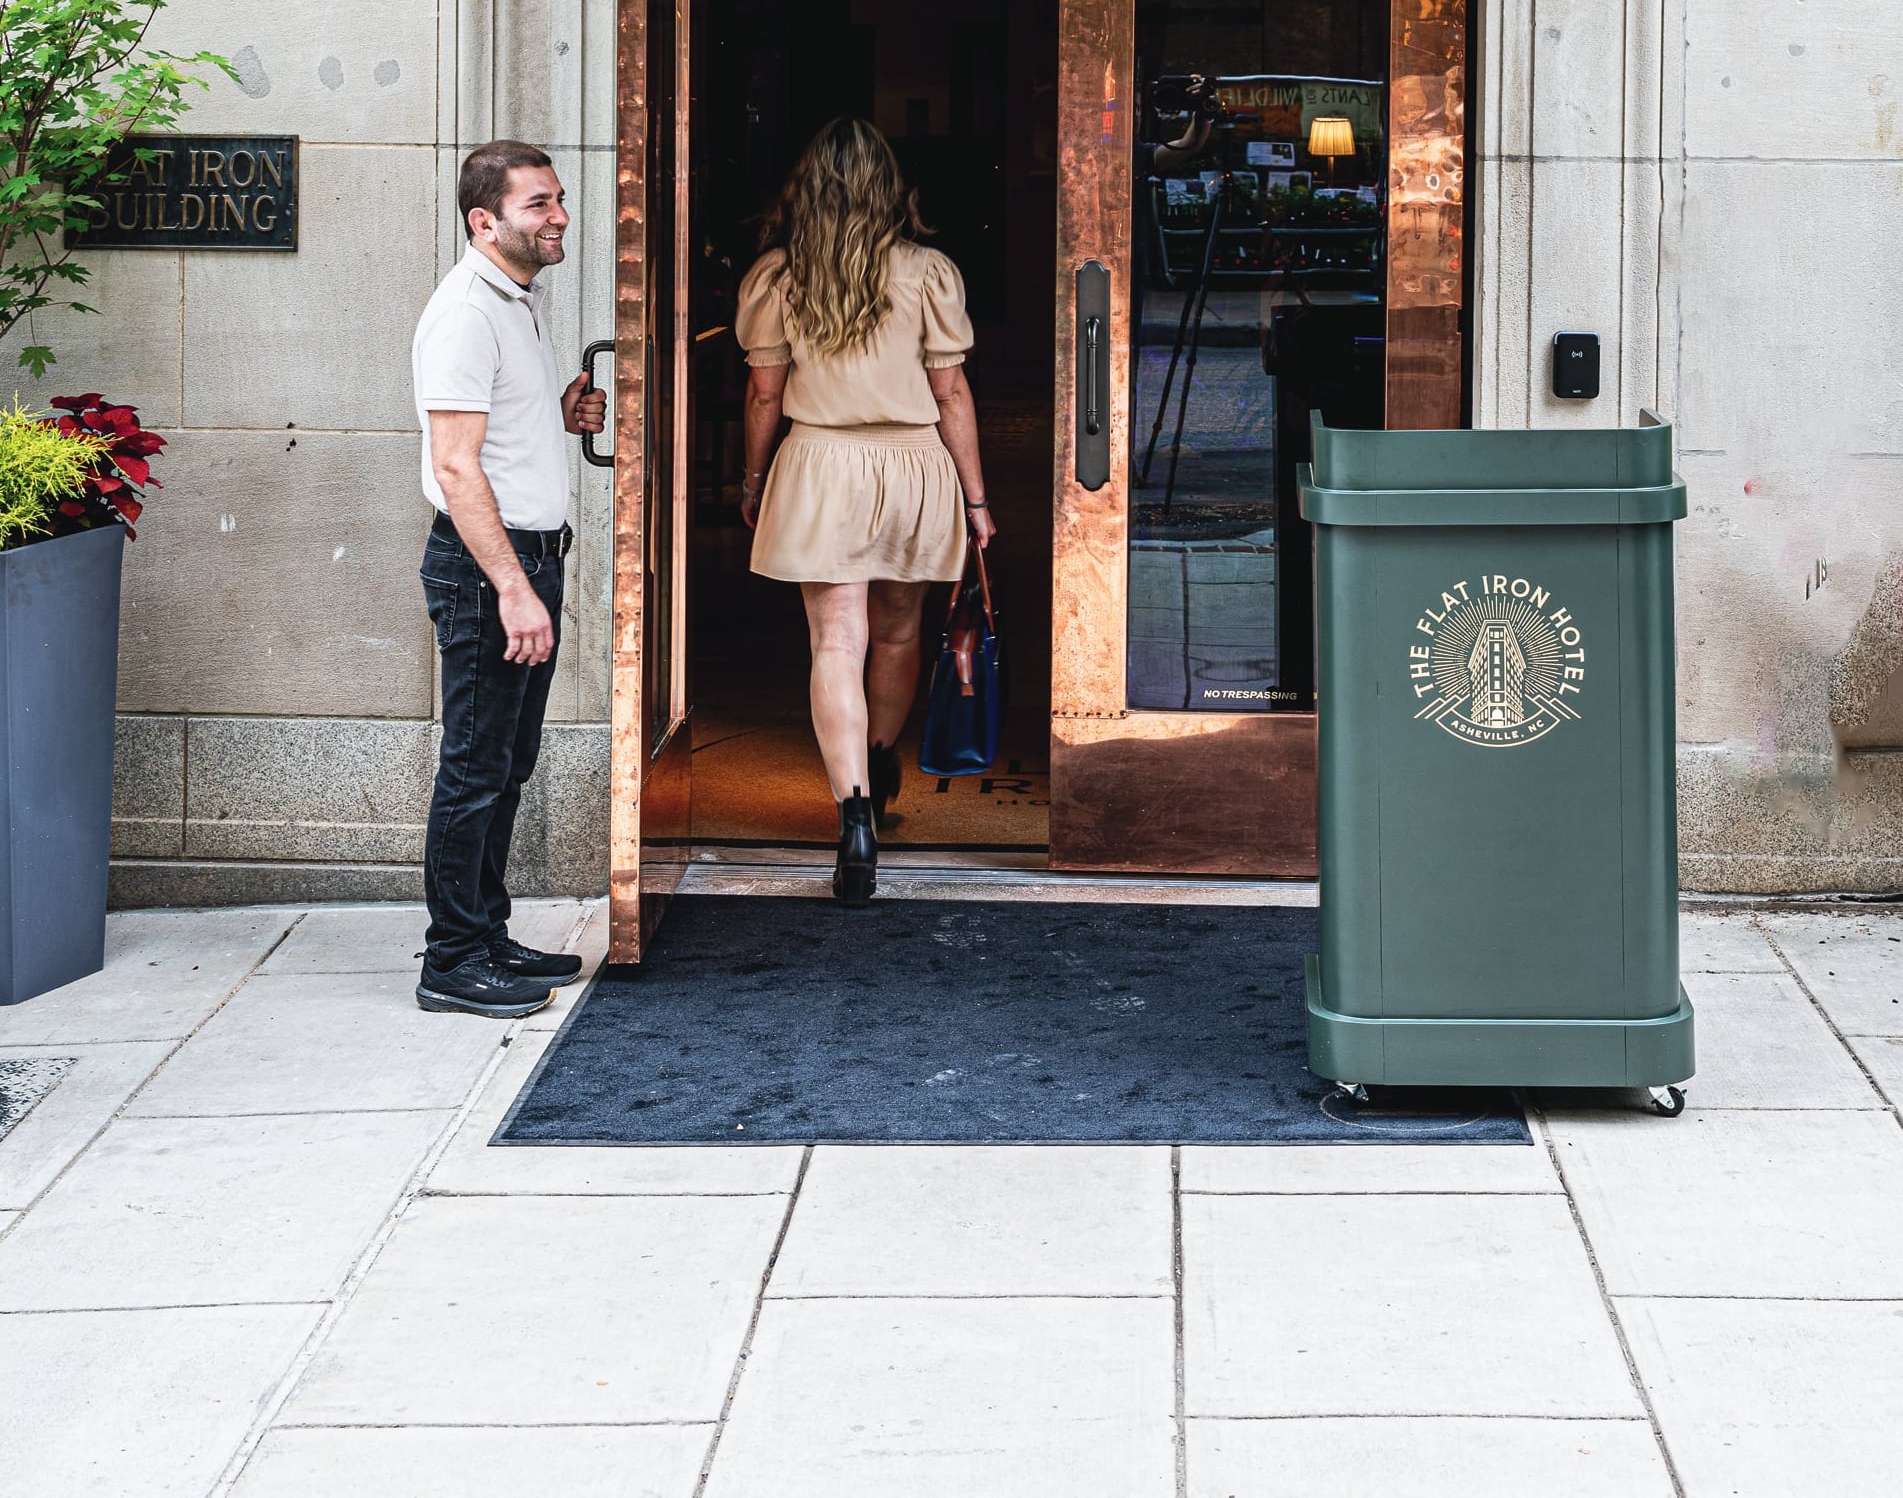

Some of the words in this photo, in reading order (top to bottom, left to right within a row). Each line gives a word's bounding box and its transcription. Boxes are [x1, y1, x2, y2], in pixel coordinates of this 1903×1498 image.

[96, 149, 175, 187] LAT
[188, 149, 286, 188] IRON
[87, 192, 277, 233] BUILDING
[1416, 580, 1470, 637] FLAT
[1481, 574, 1551, 609] IRON
[1549, 606, 1585, 695] HOTEL
[1409, 645, 1435, 698] THE
[1203, 689, 1220, 699] NO
[1221, 689, 1298, 701] TRESPASSING
[1528, 718, 1545, 733] NC
